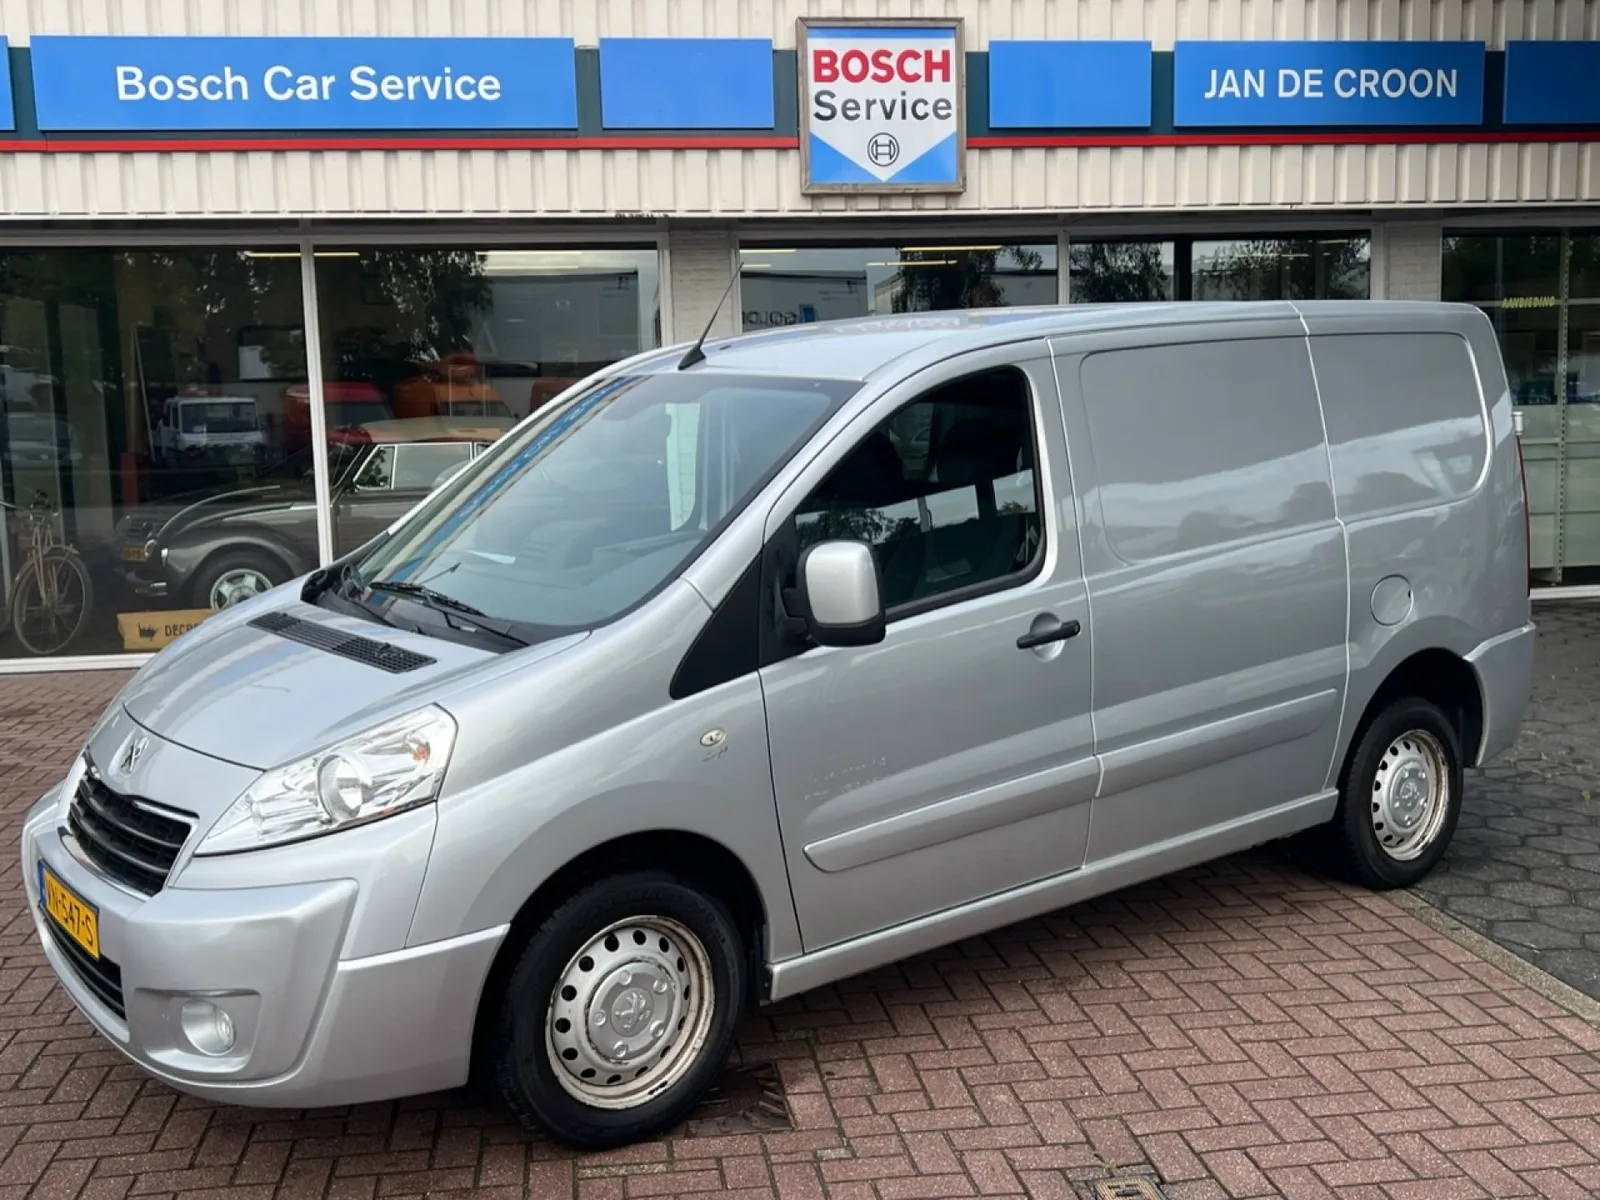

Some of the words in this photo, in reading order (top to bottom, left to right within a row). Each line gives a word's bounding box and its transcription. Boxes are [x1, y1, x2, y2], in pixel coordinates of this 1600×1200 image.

[813, 49, 952, 83] BOSCH
[116, 65, 249, 102] Bosch
[263, 65, 336, 102] Car
[350, 65, 502, 102] Service
[1204, 69, 1265, 99] JAN
[1278, 69, 1323, 98] DE
[1334, 69, 1457, 98] CROON
[813, 90, 953, 121] Service
